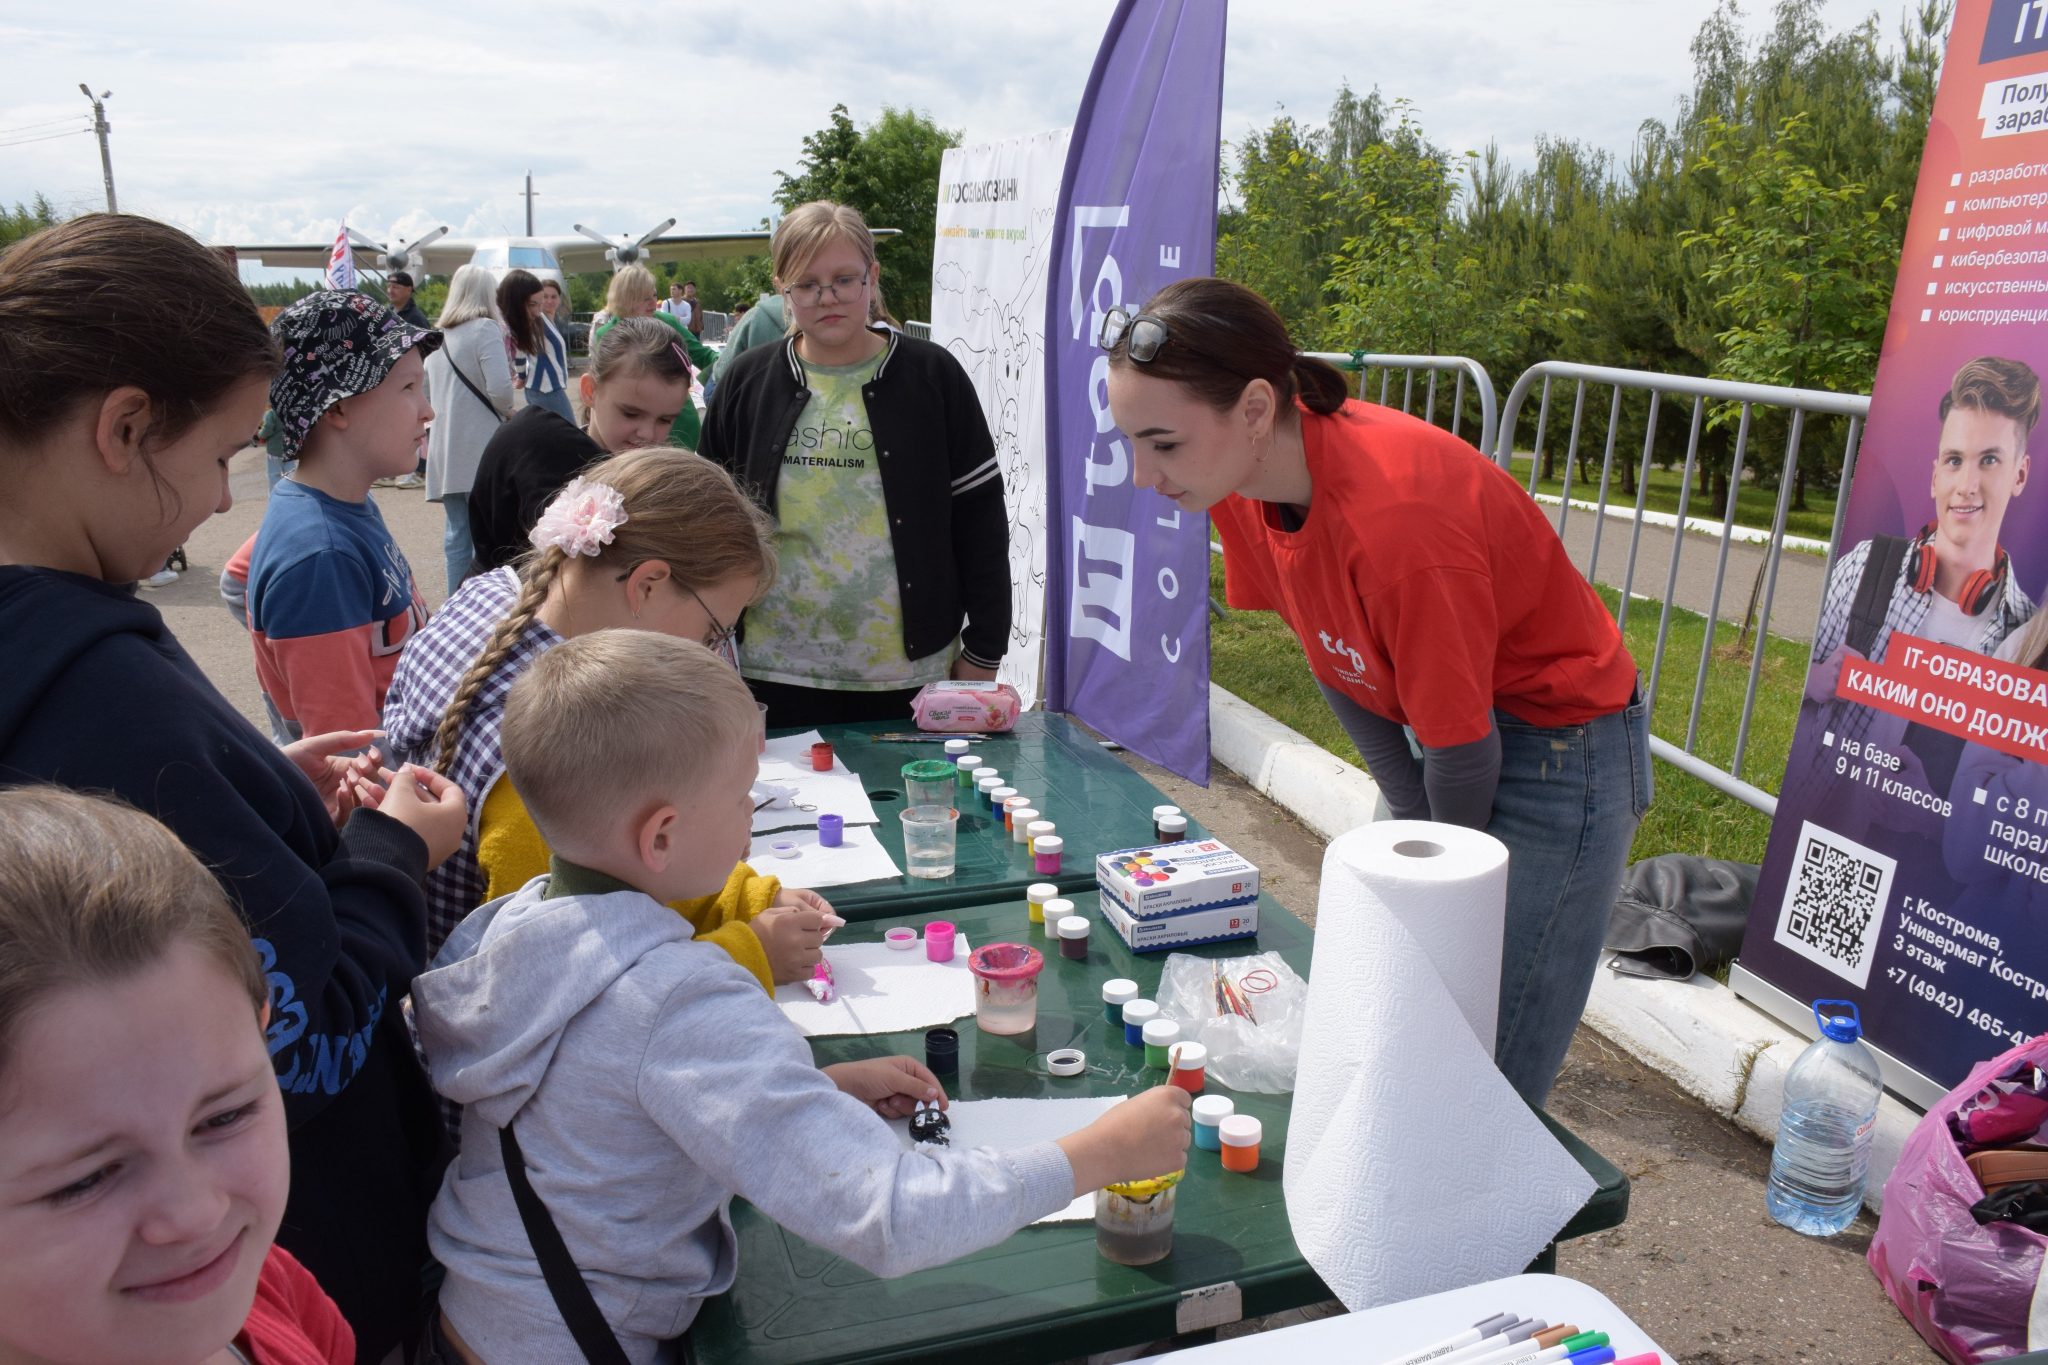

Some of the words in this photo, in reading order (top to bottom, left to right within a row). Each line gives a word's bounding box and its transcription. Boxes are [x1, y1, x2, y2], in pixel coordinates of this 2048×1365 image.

[2001, 83, 2048, 105] Полу
[1963, 191, 2048, 210] компьютер
[1957, 219, 2032, 242] цифровой
[1938, 308, 2048, 326] юриспруденци
[783, 455, 865, 468] MATERIALISM
[1847, 669, 1918, 709] КАКИМ
[1920, 692, 1967, 724] ОНО
[1968, 708, 2048, 753] ДОЛЖ
[1840, 737, 1860, 756] на
[1864, 743, 1900, 771] базе
[1835, 756, 1847, 775] 9
[1850, 766, 1861, 781] и
[1865, 768, 1880, 788] 11
[1881, 778, 1953, 818] классов
[1996, 796, 2010, 812] с
[2014, 798, 2030, 819] 8
[1983, 844, 2048, 884] школе
[1899, 913, 1987, 968] Универмаг
[1903, 896, 1913, 911] г.
[1916, 898, 2003, 956] Кострома,
[1893, 934, 1904, 951] 3
[1906, 943, 1948, 974] этаж
[1887, 966, 1907, 985] +7
[1908, 974, 1964, 1018] (4942)
